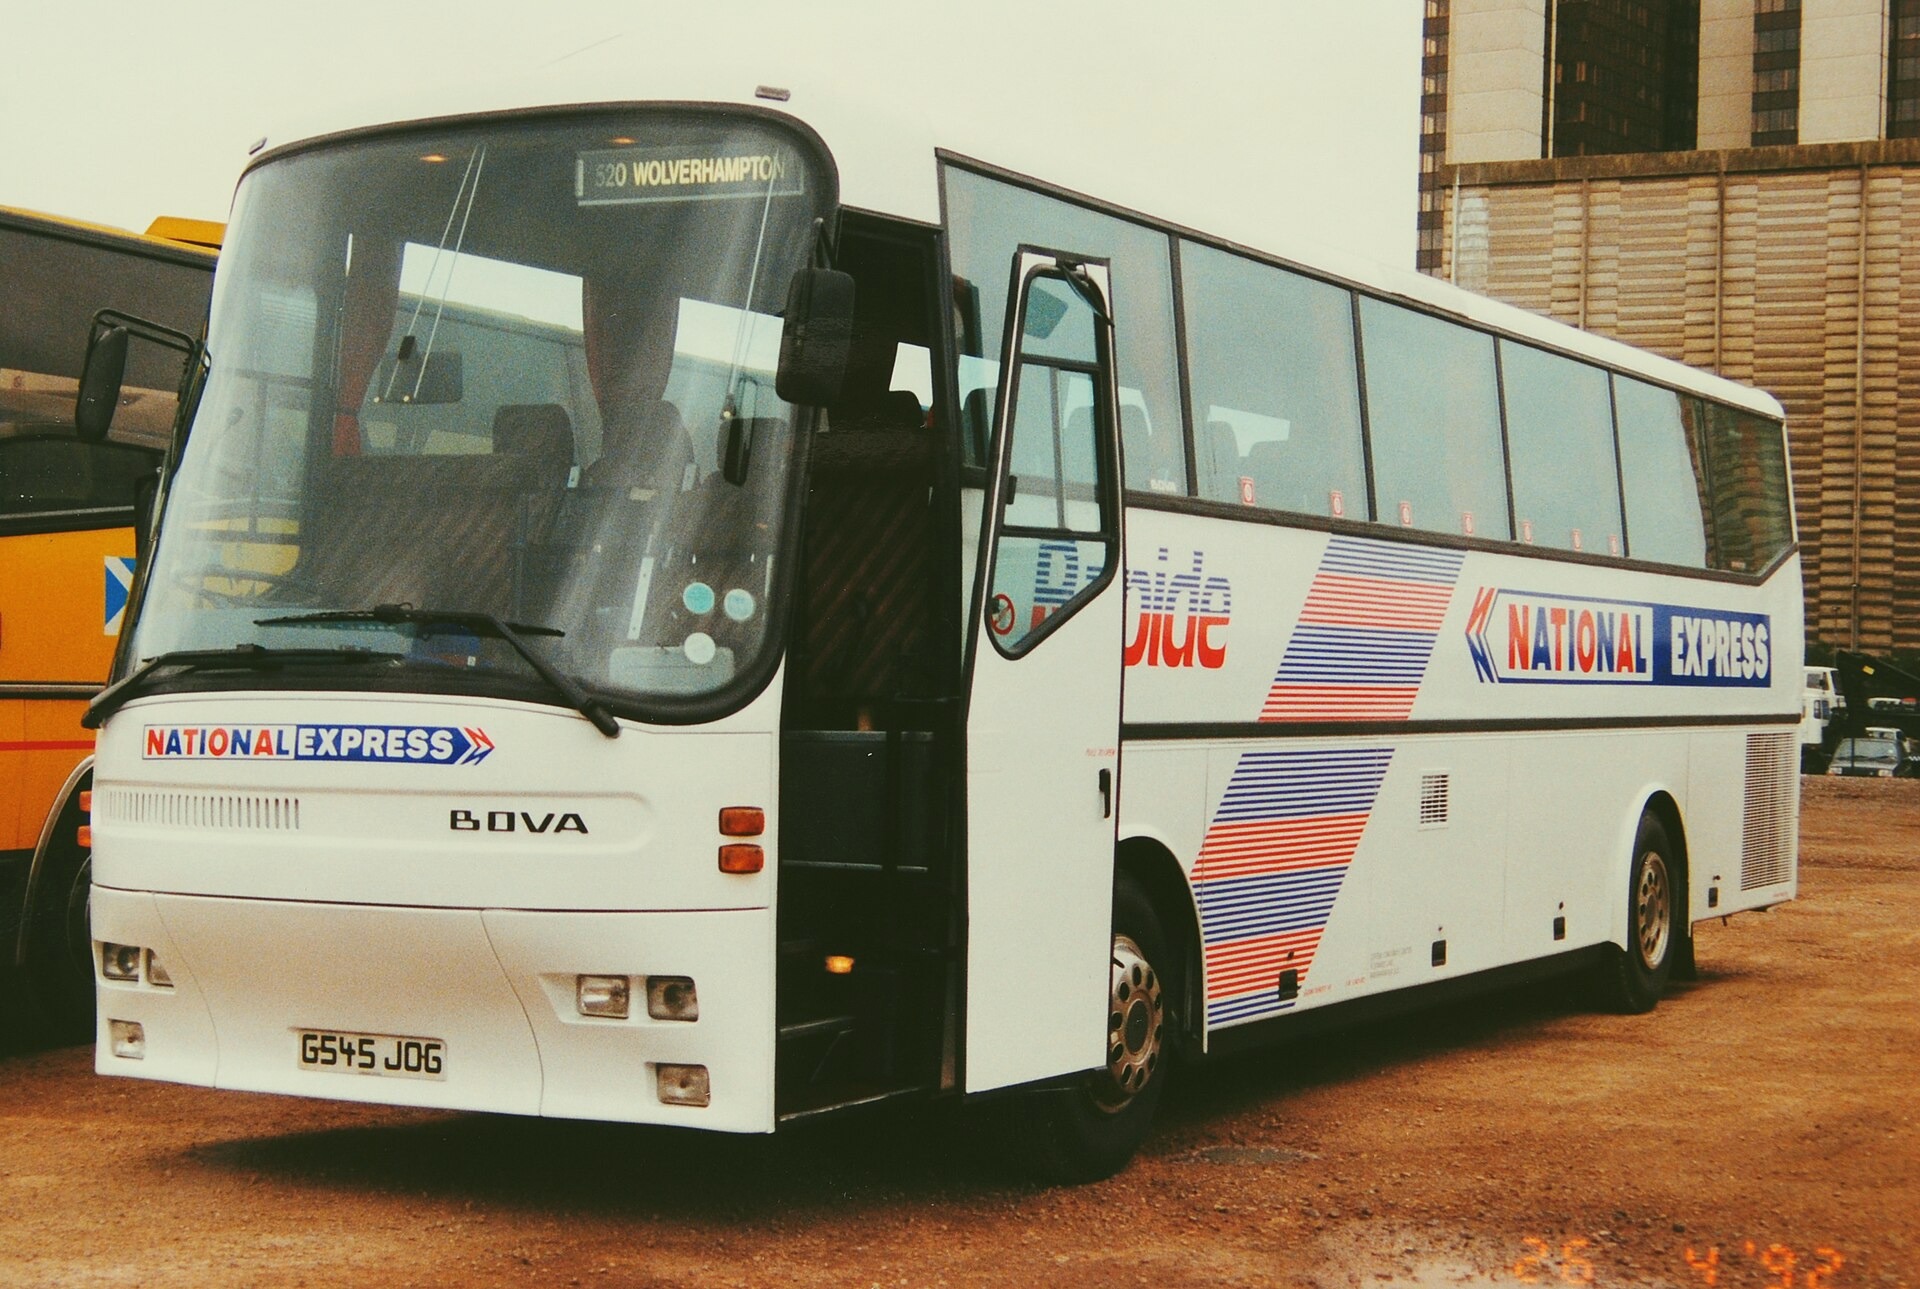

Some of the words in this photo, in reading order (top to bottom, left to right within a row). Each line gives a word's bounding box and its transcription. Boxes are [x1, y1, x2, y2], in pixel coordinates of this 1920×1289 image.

[632, 155, 785, 187] WOLVERHAMPTON
[1508, 603, 1648, 674] NATIONAL
[1671, 615, 1769, 680] EXPRESS
[146, 728, 290, 757] NATIONAL
[296, 728, 453, 760] EXPRESS
[450, 809, 589, 834] BOVA
[302, 1033, 376, 1069] G545
[384, 1040, 442, 1074] JOG
